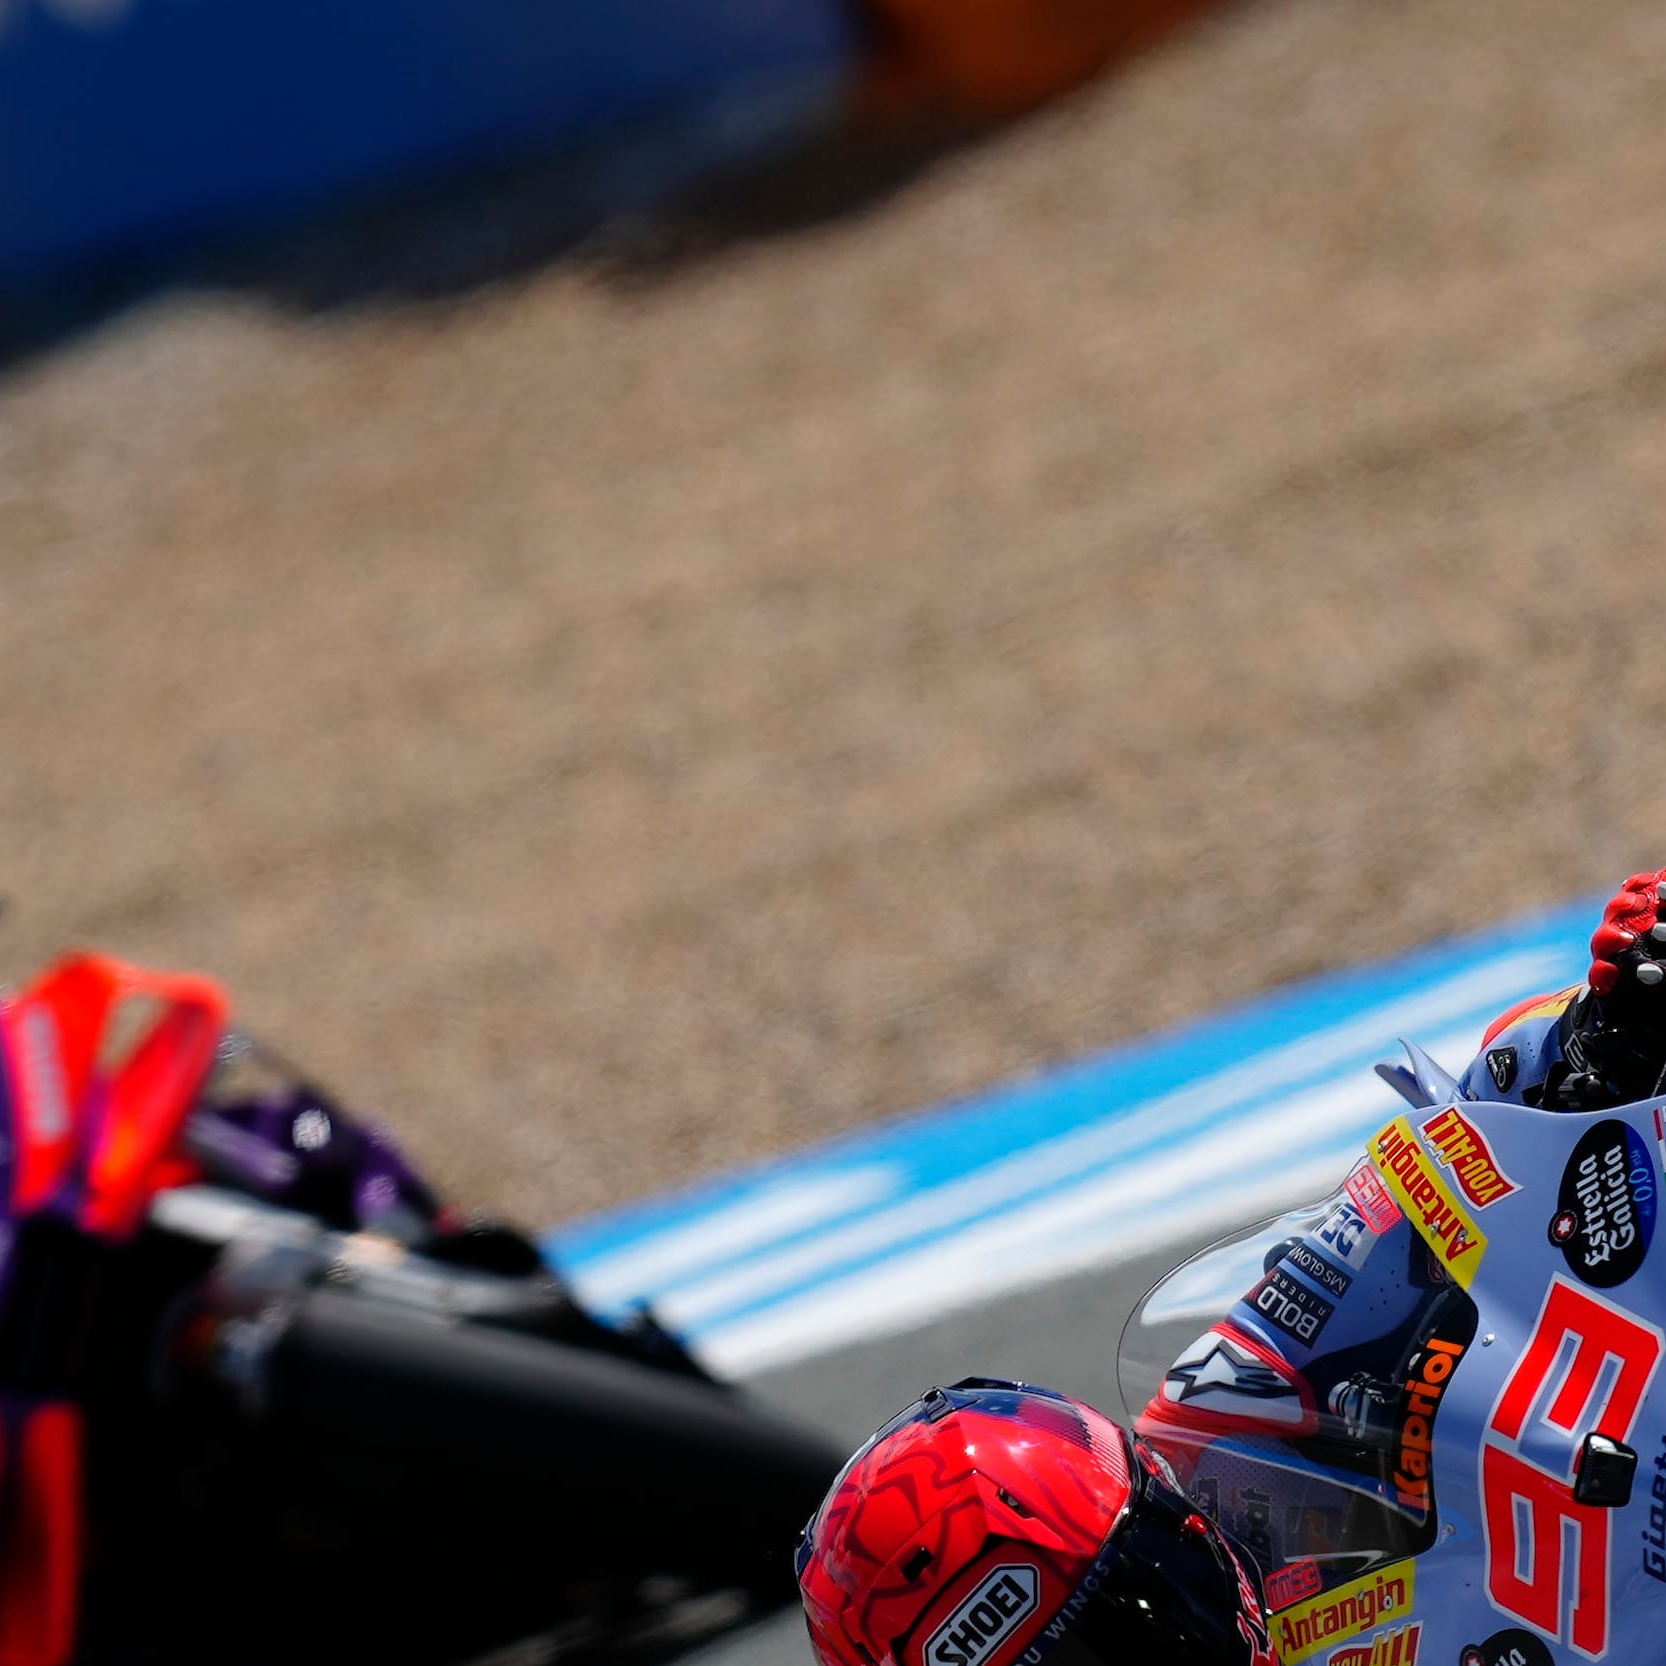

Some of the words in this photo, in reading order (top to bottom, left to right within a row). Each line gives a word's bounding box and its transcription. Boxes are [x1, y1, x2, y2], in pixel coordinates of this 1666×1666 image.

[1380, 1123, 1478, 1263] Antangin
[1424, 1110, 1506, 1203] YOU-ALL
[1601, 1144, 1635, 1250] Galicia
[1315, 1204, 1367, 1258] DE
[1575, 1153, 1611, 1267] Estrella
[1271, 1272, 1327, 1316] RIDERS
[1290, 1245, 1326, 1277] GLOW
[1323, 1269, 1348, 1293] MS
[1256, 1284, 1320, 1340] BOLD
[1394, 1338, 1465, 1512] Kapriol
[1481, 1274, 1665, 1660] 93
[1045, 1559, 1111, 1642] WINGS
[1282, 1575, 1406, 1655] Antangin
